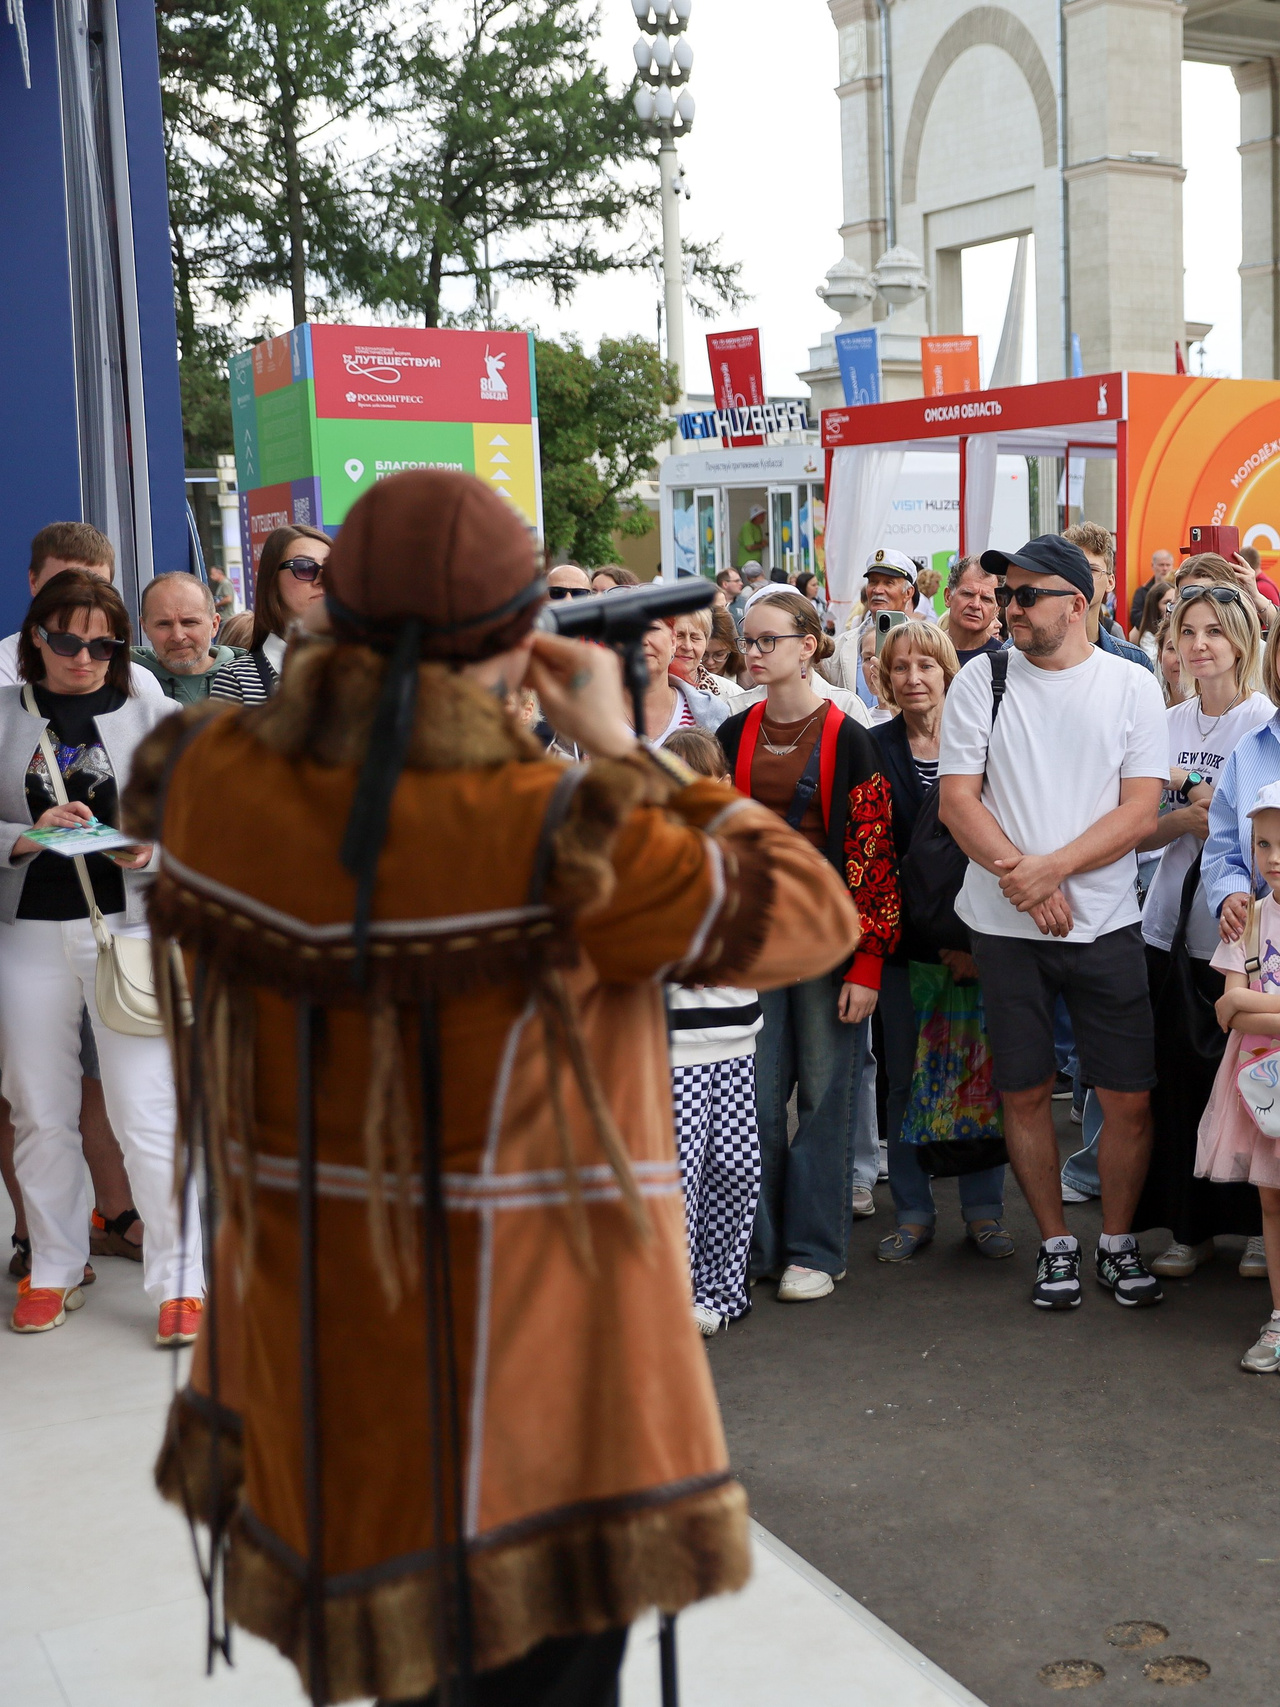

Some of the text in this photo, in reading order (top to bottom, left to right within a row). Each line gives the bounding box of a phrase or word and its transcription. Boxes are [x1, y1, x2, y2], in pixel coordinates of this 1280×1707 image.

[354, 355, 441, 368] ПУТЕШЕСТВУЙ!
[357, 393, 424, 404] РОСКОНГРЕСС
[924, 400, 1003, 423] ОМСКАЯ ОБЛАСТЬ
[716, 401, 807, 437] KUZBASS
[375, 460, 463, 472] БЛАГОДАРИМ
[892, 500, 924, 511] VISIT
[885, 523, 922, 534] ДОБРО
